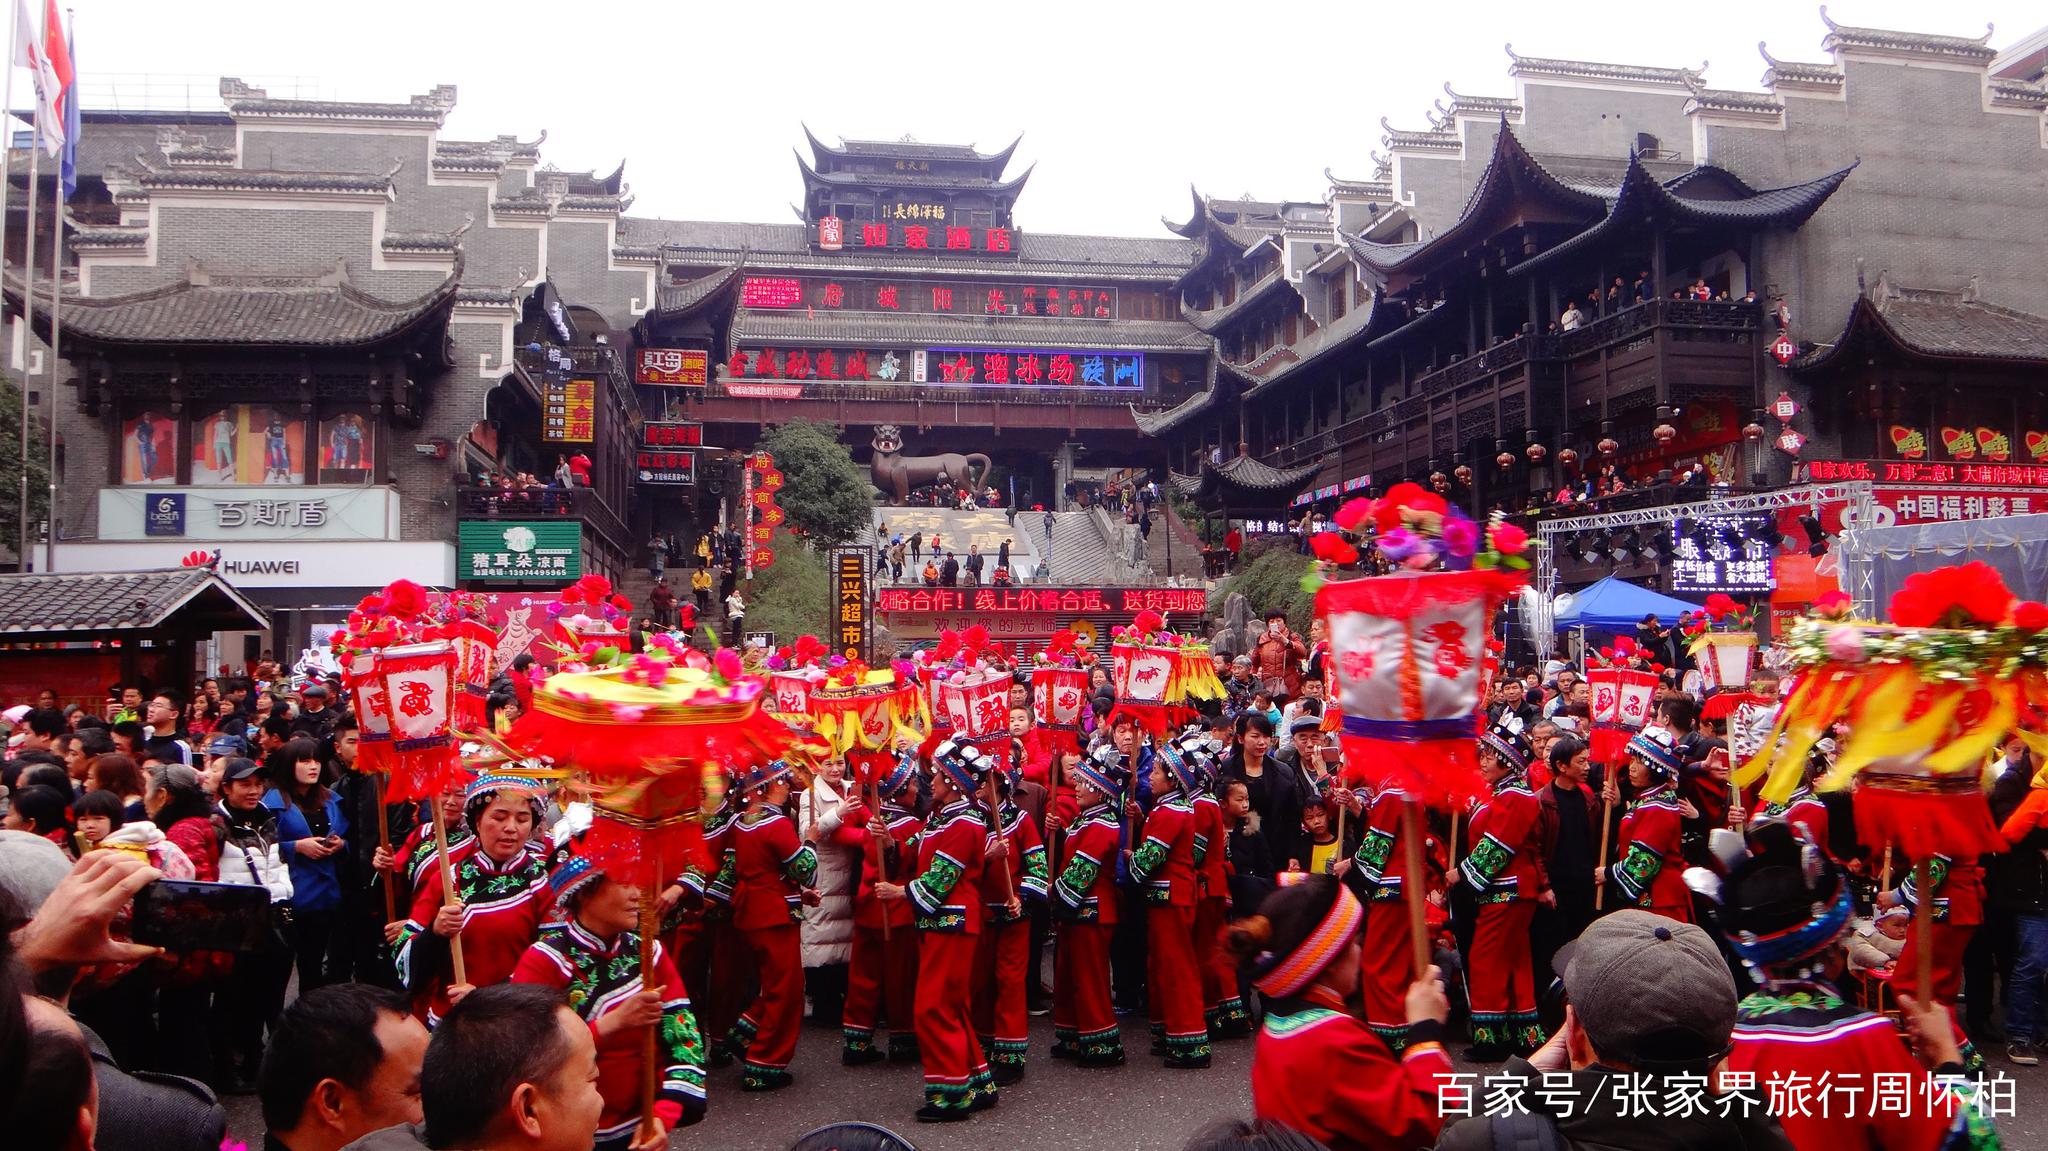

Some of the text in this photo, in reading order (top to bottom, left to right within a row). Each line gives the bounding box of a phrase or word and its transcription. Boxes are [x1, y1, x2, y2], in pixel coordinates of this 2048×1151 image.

[862, 223, 1011, 252] 如家酒店
[821, 284, 1007, 314] 府城阳光
[984, 353, 1075, 384] 溜冰场
[214, 499, 328, 528] 百斯盾
[755, 456, 781, 568] 府城商务酒店
[1897, 495, 2031, 520] 中国福利彩票
[224, 561, 299, 574] HUAWEI
[472, 553, 566, 568] 猪耳朵 凉面
[841, 559, 861, 645] 三兴超市
[934, 616, 1056, 633] 欢迎您的光临
